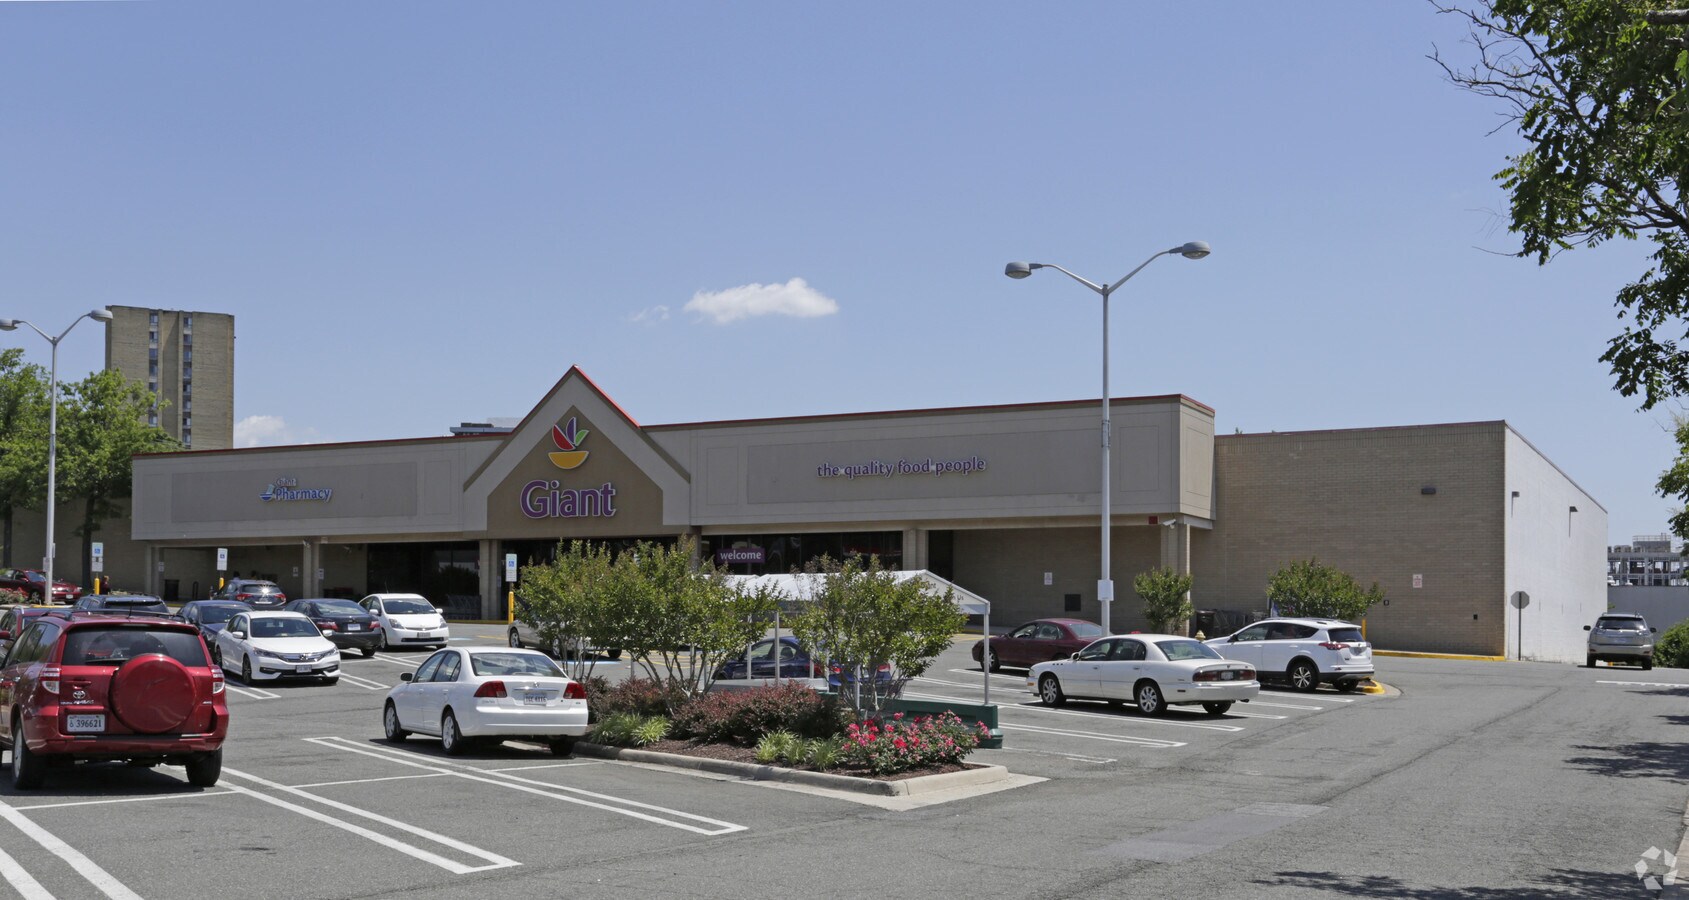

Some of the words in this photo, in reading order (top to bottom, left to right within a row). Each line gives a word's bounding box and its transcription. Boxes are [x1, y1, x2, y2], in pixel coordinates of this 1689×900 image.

[817, 463, 840, 477] the
[843, 460, 894, 479] quality
[898, 459, 931, 474] food
[935, 456, 986, 476] people
[275, 488, 332, 502] Pharmacy
[520, 480, 616, 518] Giant
[720, 549, 762, 560] welcome
